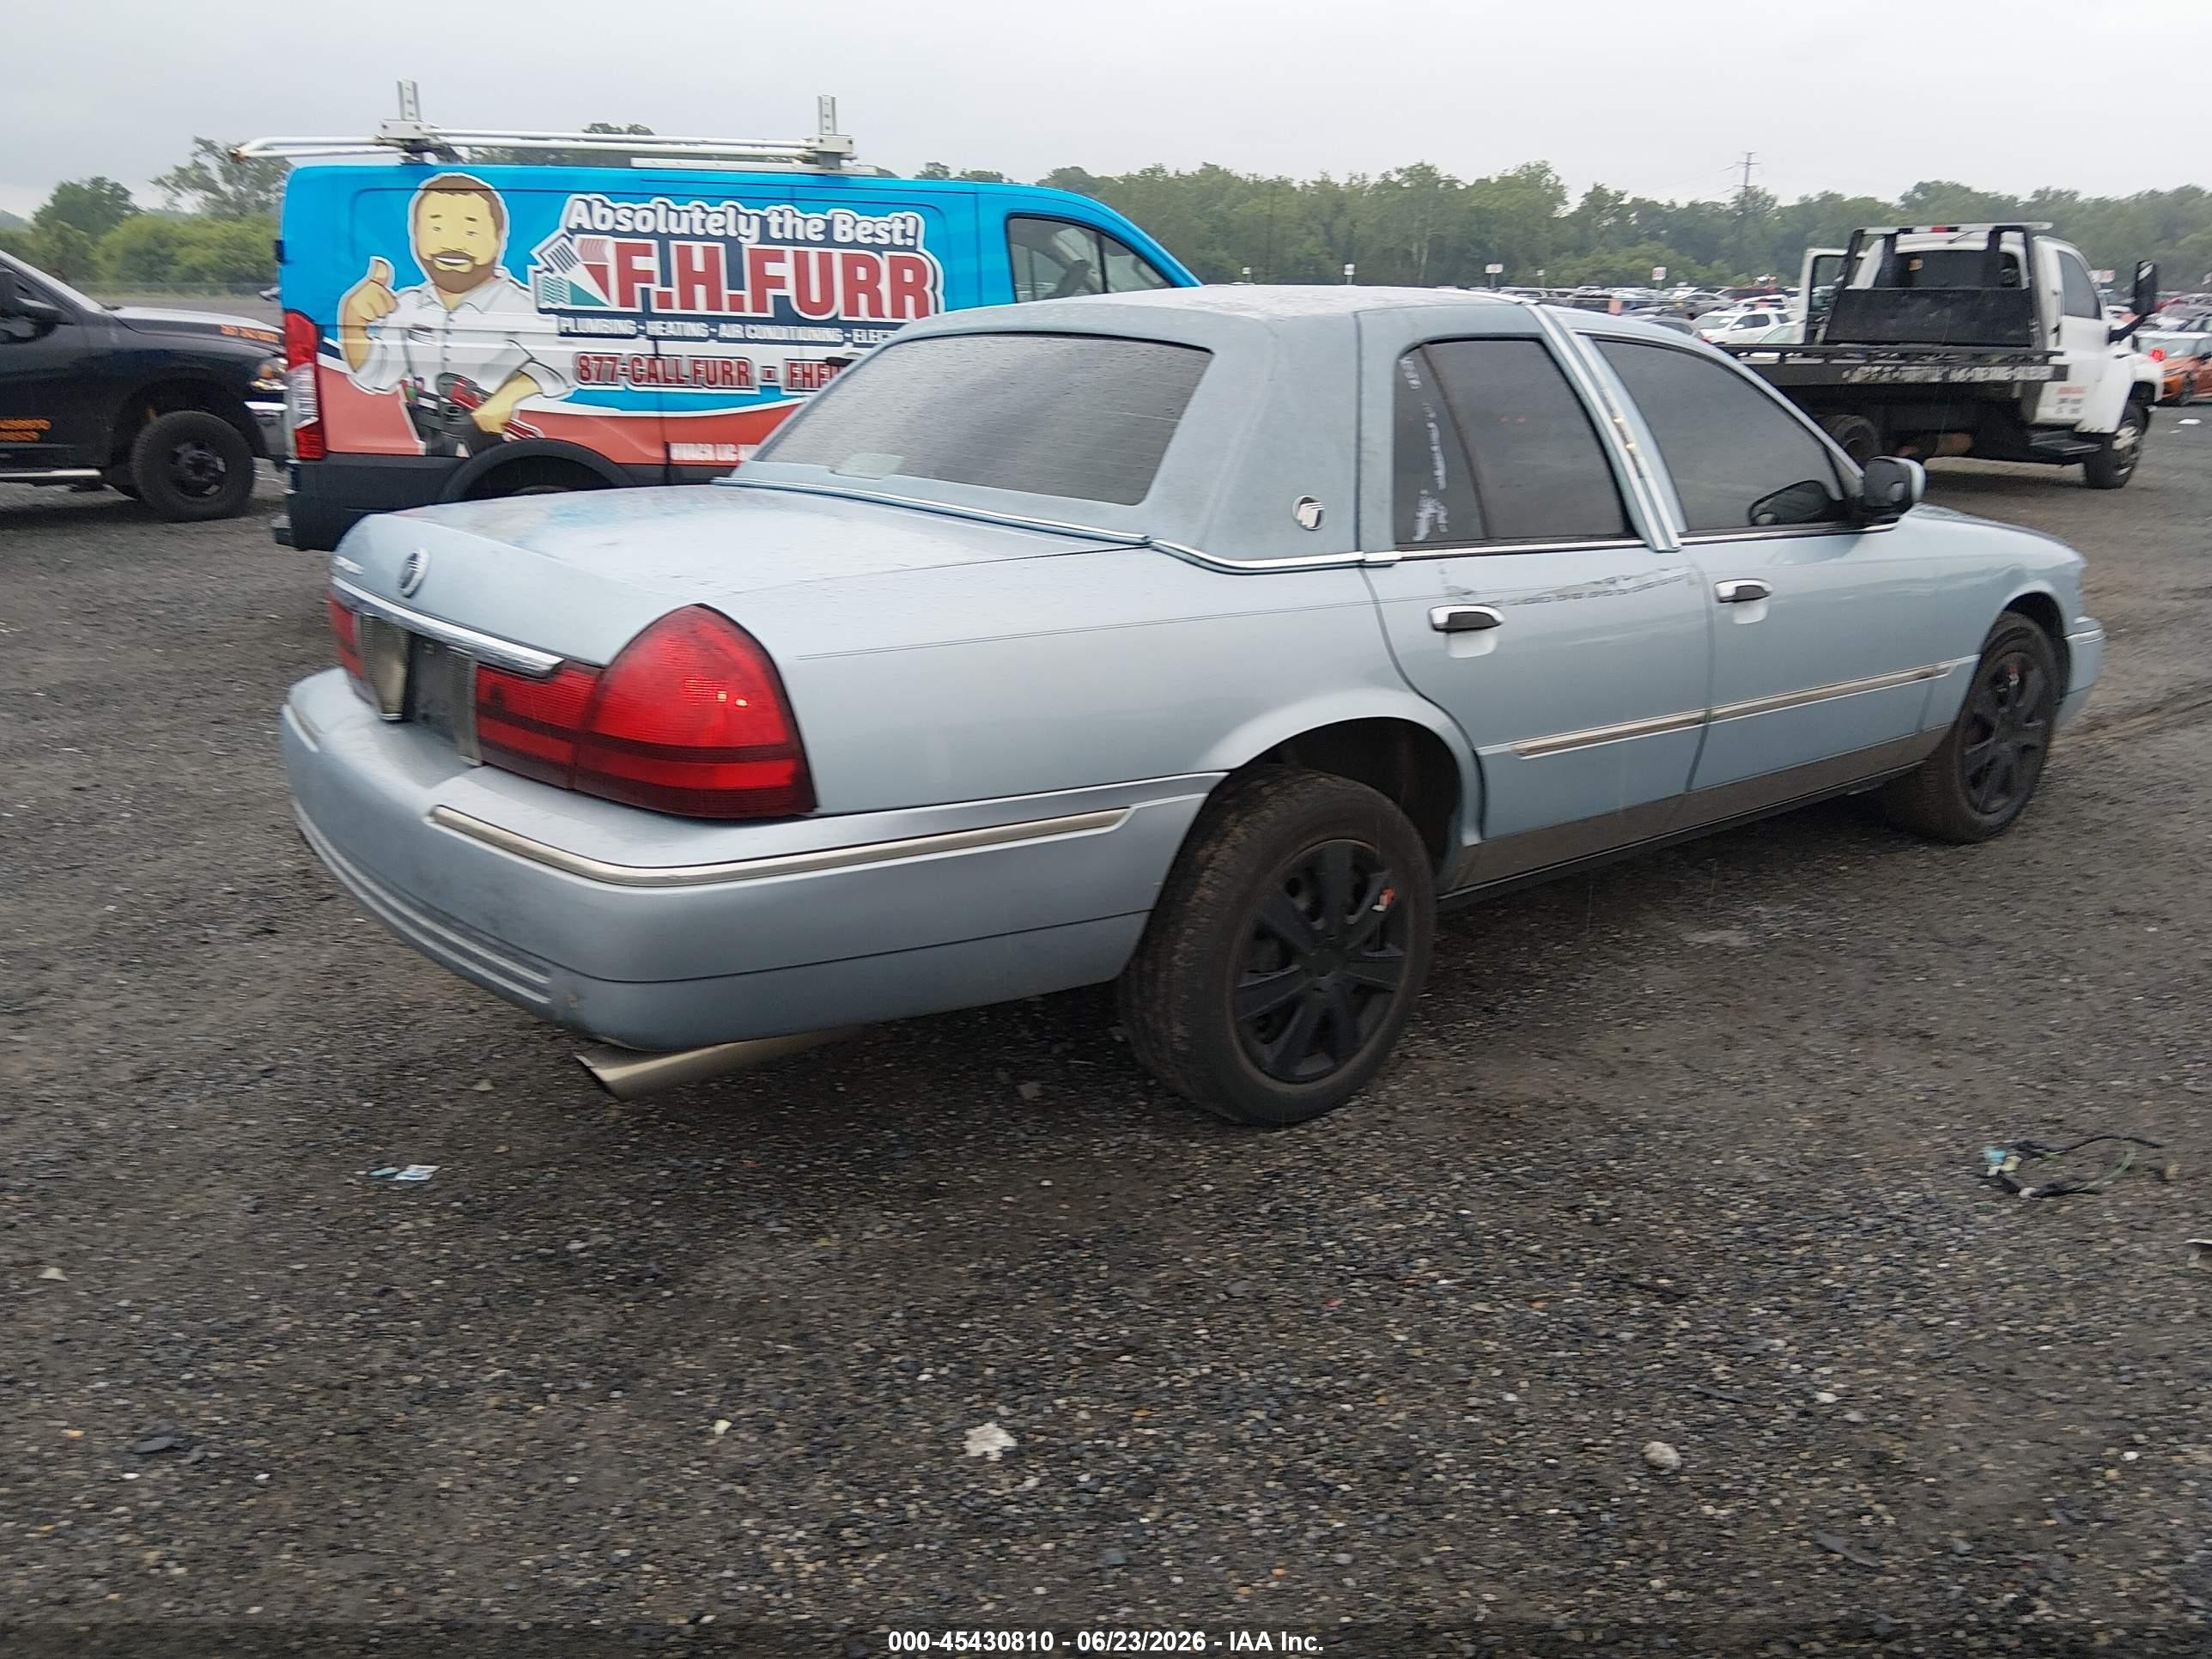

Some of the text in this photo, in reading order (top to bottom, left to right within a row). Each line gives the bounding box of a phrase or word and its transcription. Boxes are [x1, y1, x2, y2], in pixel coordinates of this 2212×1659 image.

[567, 198, 917, 246] Absolutely the Best!
[560, 317, 637, 335] PLUMBING
[646, 320, 709, 337] HEATING
[718, 323, 744, 339] AIR
[692, 359, 750, 386] FURR
